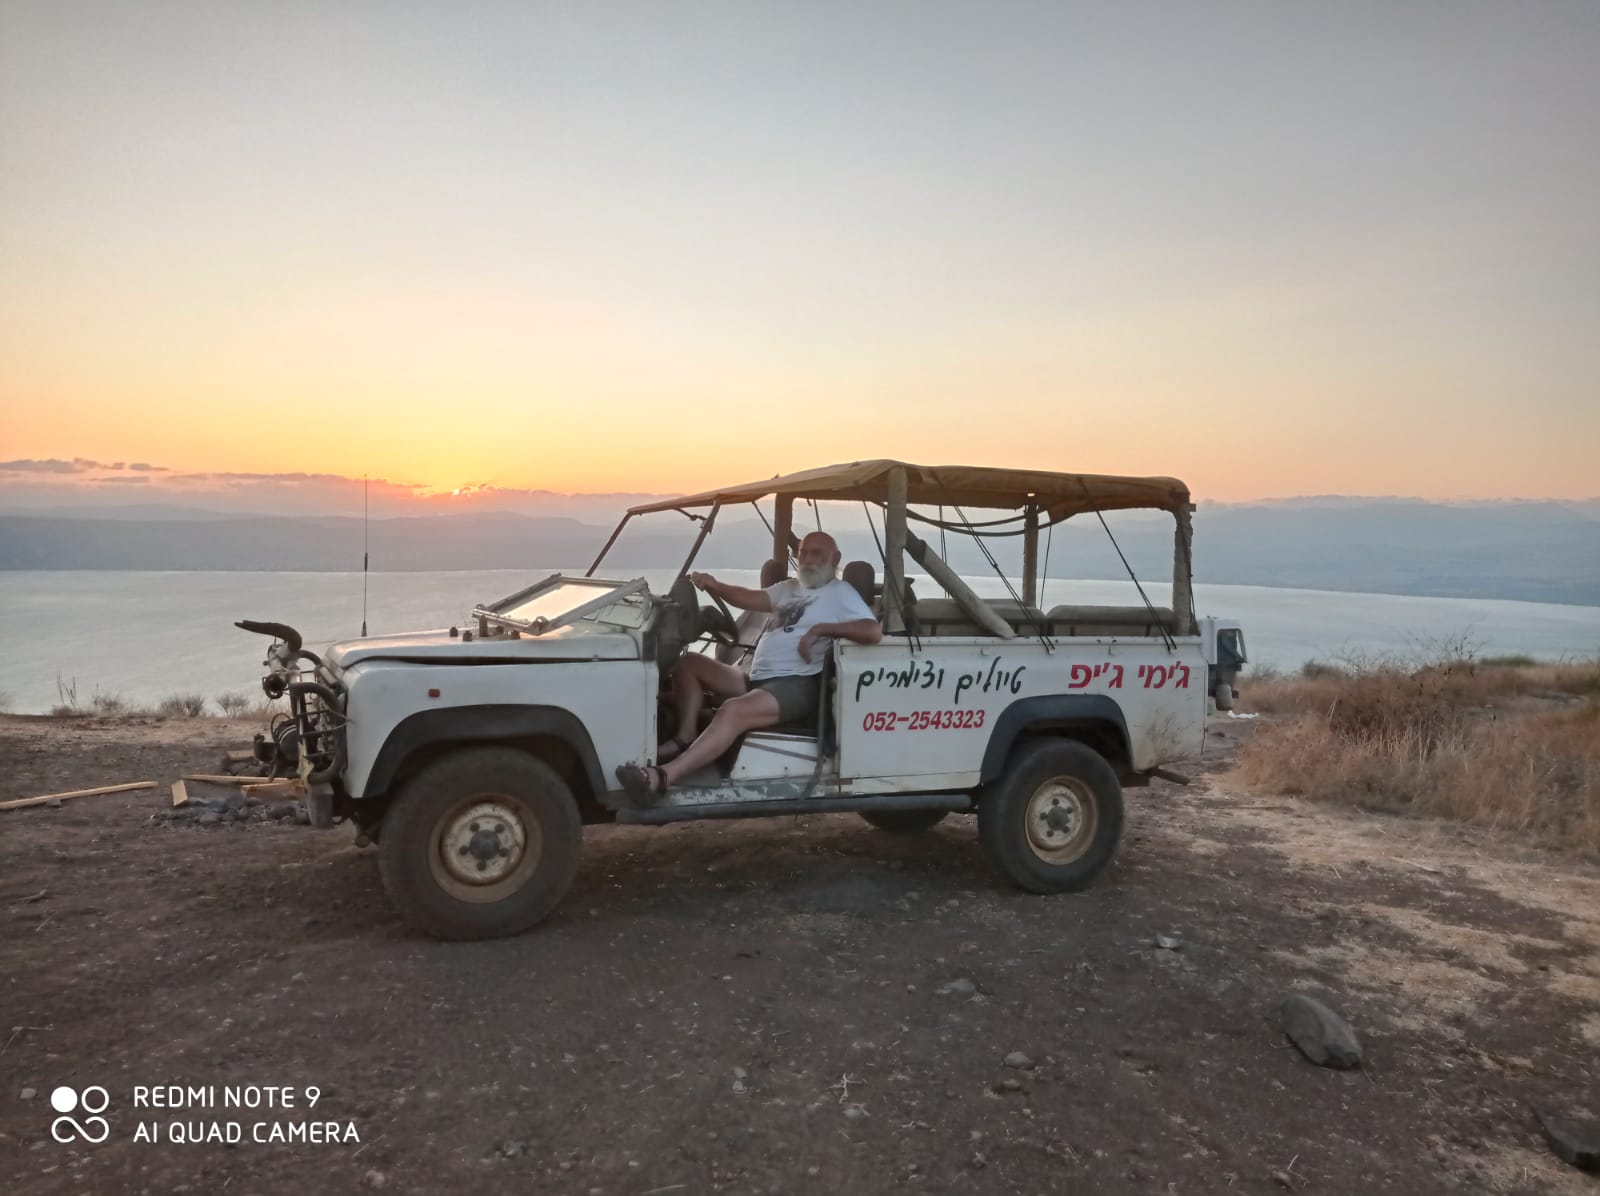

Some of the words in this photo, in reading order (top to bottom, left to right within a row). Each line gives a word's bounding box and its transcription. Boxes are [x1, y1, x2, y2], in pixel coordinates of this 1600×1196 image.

[855, 659, 945, 703] וצימרים
[954, 655, 1027, 705] טיולים
[1067, 662, 1124, 689] ג'יפ
[1138, 660, 1190, 689] ג'ימי
[862, 709, 986, 732] 052-2543323
